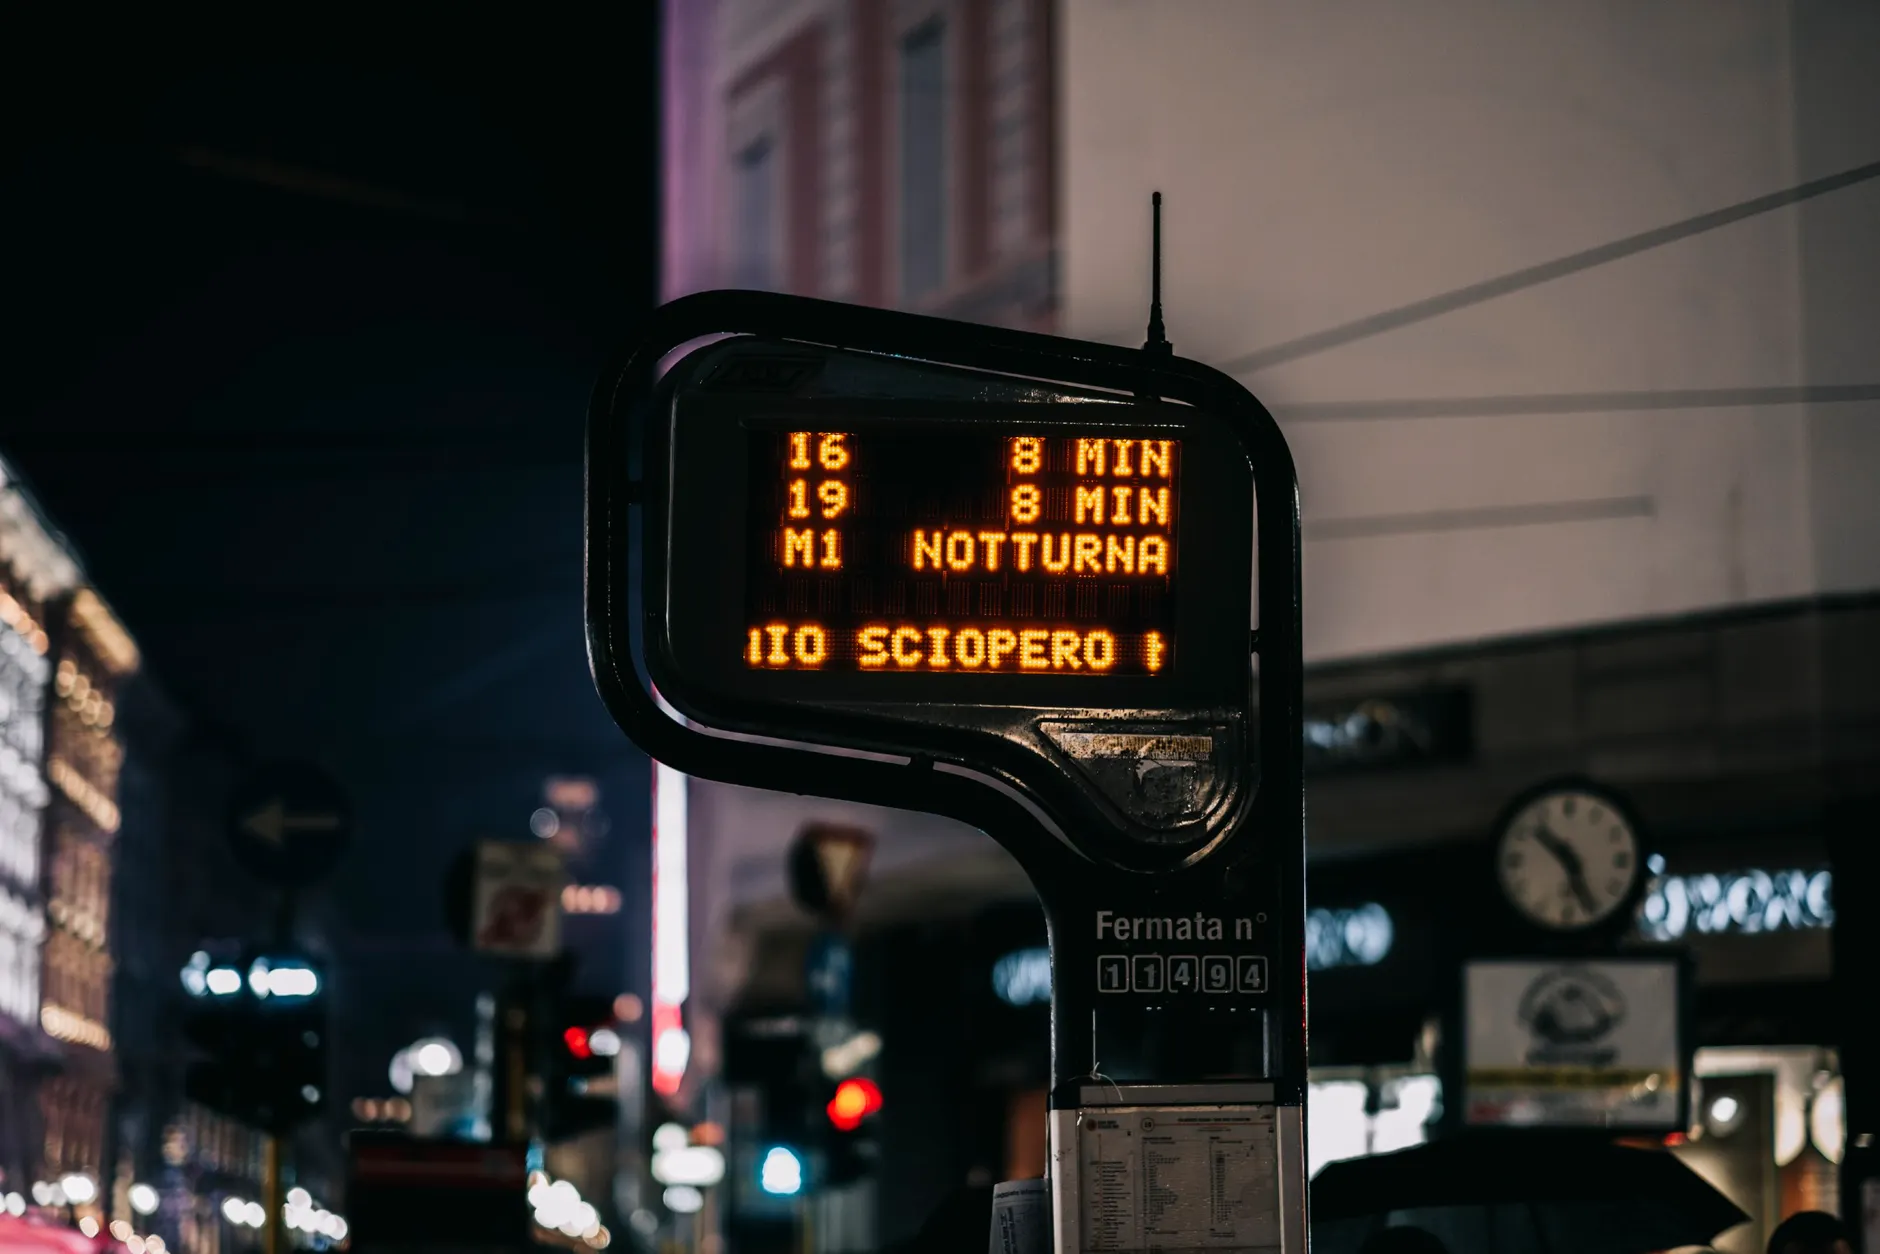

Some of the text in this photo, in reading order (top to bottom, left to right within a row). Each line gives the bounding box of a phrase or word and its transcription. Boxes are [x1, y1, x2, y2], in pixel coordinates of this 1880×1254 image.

[788, 432, 1171, 478] 16 8 MIN
[788, 479, 1171, 526] 19 8 MIN
[782, 527, 1169, 575] M1 NOTTURNA
[748, 623, 829, 667] IO
[855, 625, 1116, 672] SCIOPERO
[1096, 910, 1268, 941] Fermata n°
[1102, 959, 1265, 990] 11494
